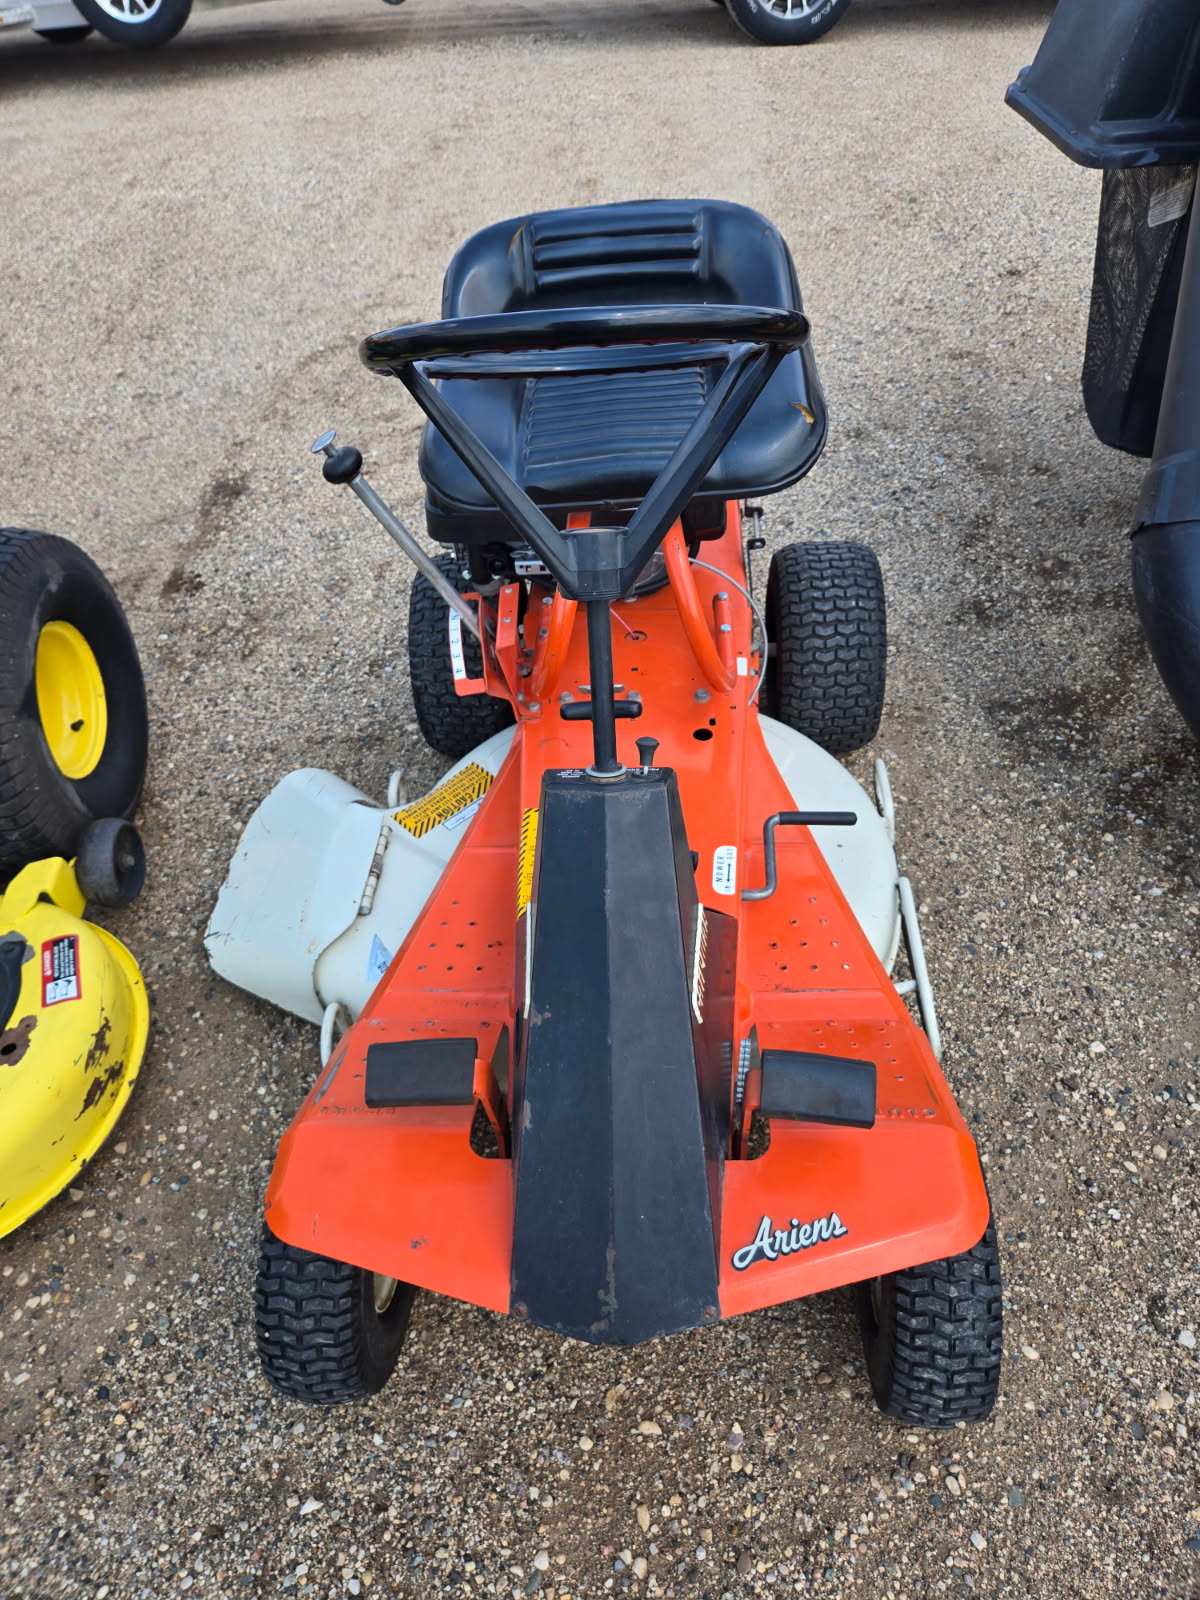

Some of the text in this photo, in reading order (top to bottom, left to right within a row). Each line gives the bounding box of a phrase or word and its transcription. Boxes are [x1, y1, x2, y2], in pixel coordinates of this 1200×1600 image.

[435, 790, 473, 819] CAUTION
[714, 855, 725, 883] MOWER
[731, 1212, 849, 1271] Ariens
